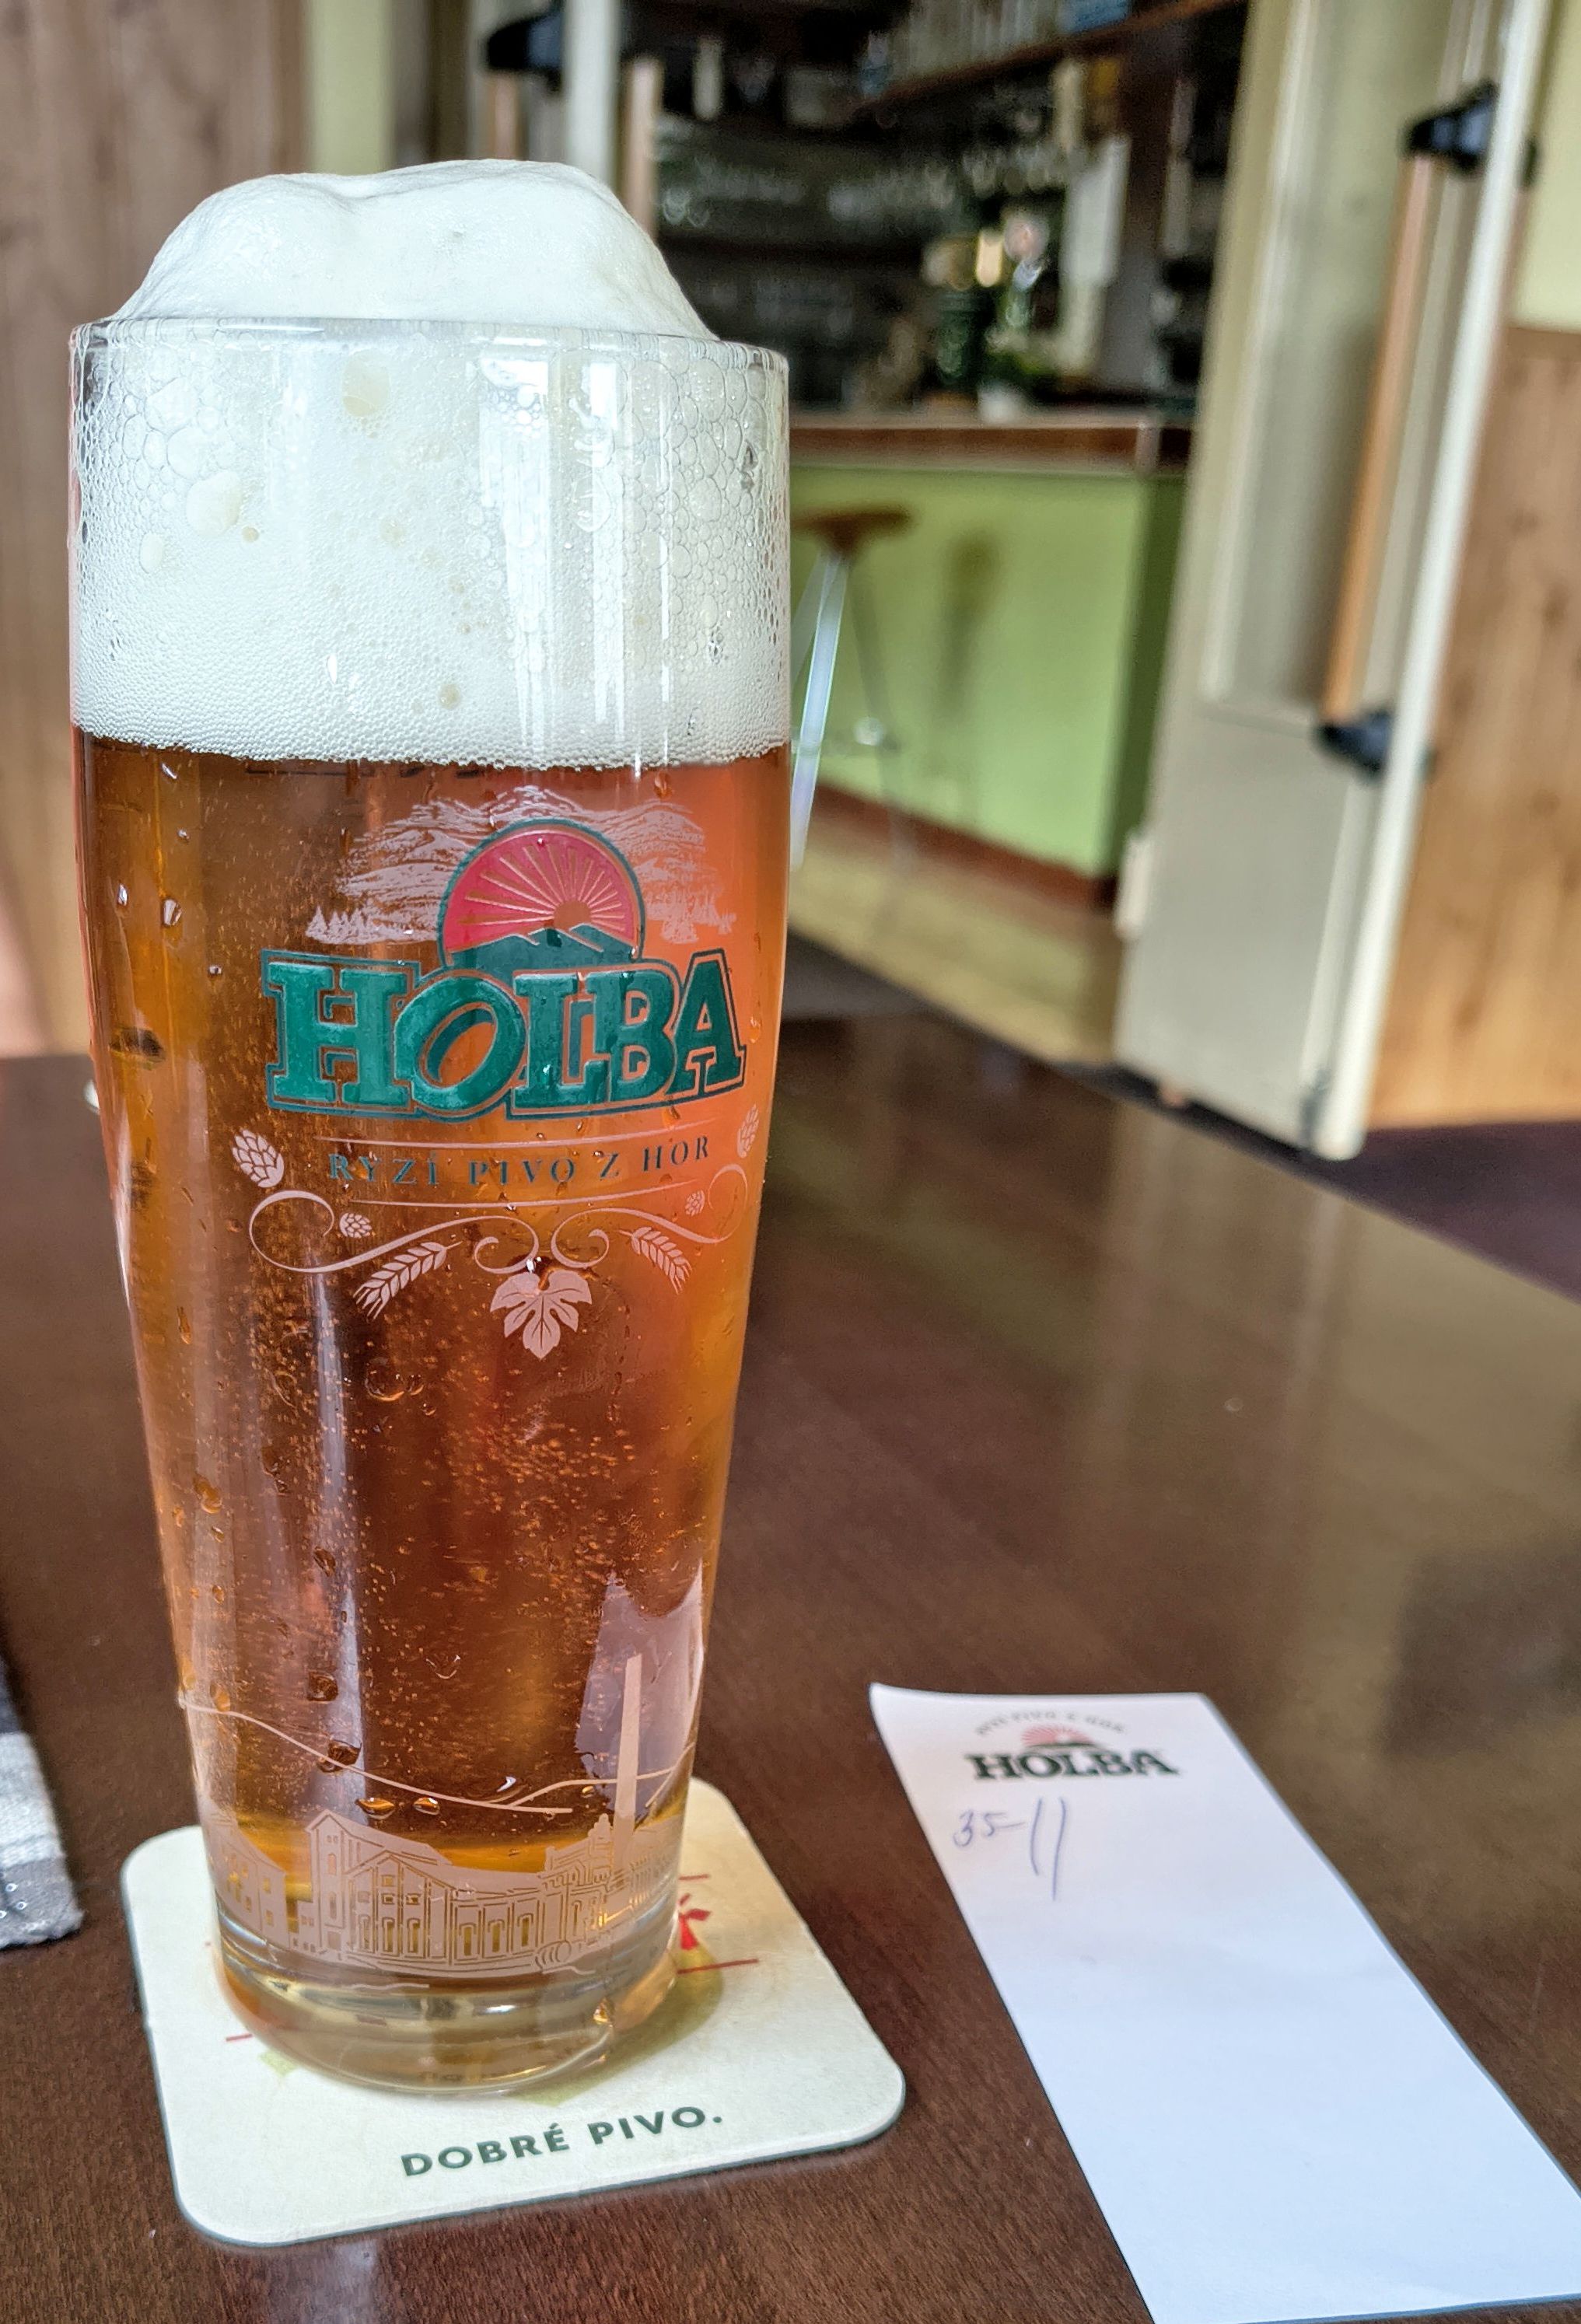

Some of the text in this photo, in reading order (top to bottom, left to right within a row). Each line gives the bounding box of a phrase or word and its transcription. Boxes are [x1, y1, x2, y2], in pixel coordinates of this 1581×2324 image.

[263, 948, 747, 1123] HOLBA
[468, 1155, 575, 1186] PIVO
[600, 1151, 621, 1182] Z
[642, 1135, 708, 1172] HOR
[965, 1748, 1181, 1781] HOLBA
[400, 2106, 723, 2177] DOBRÉ PIVO.
